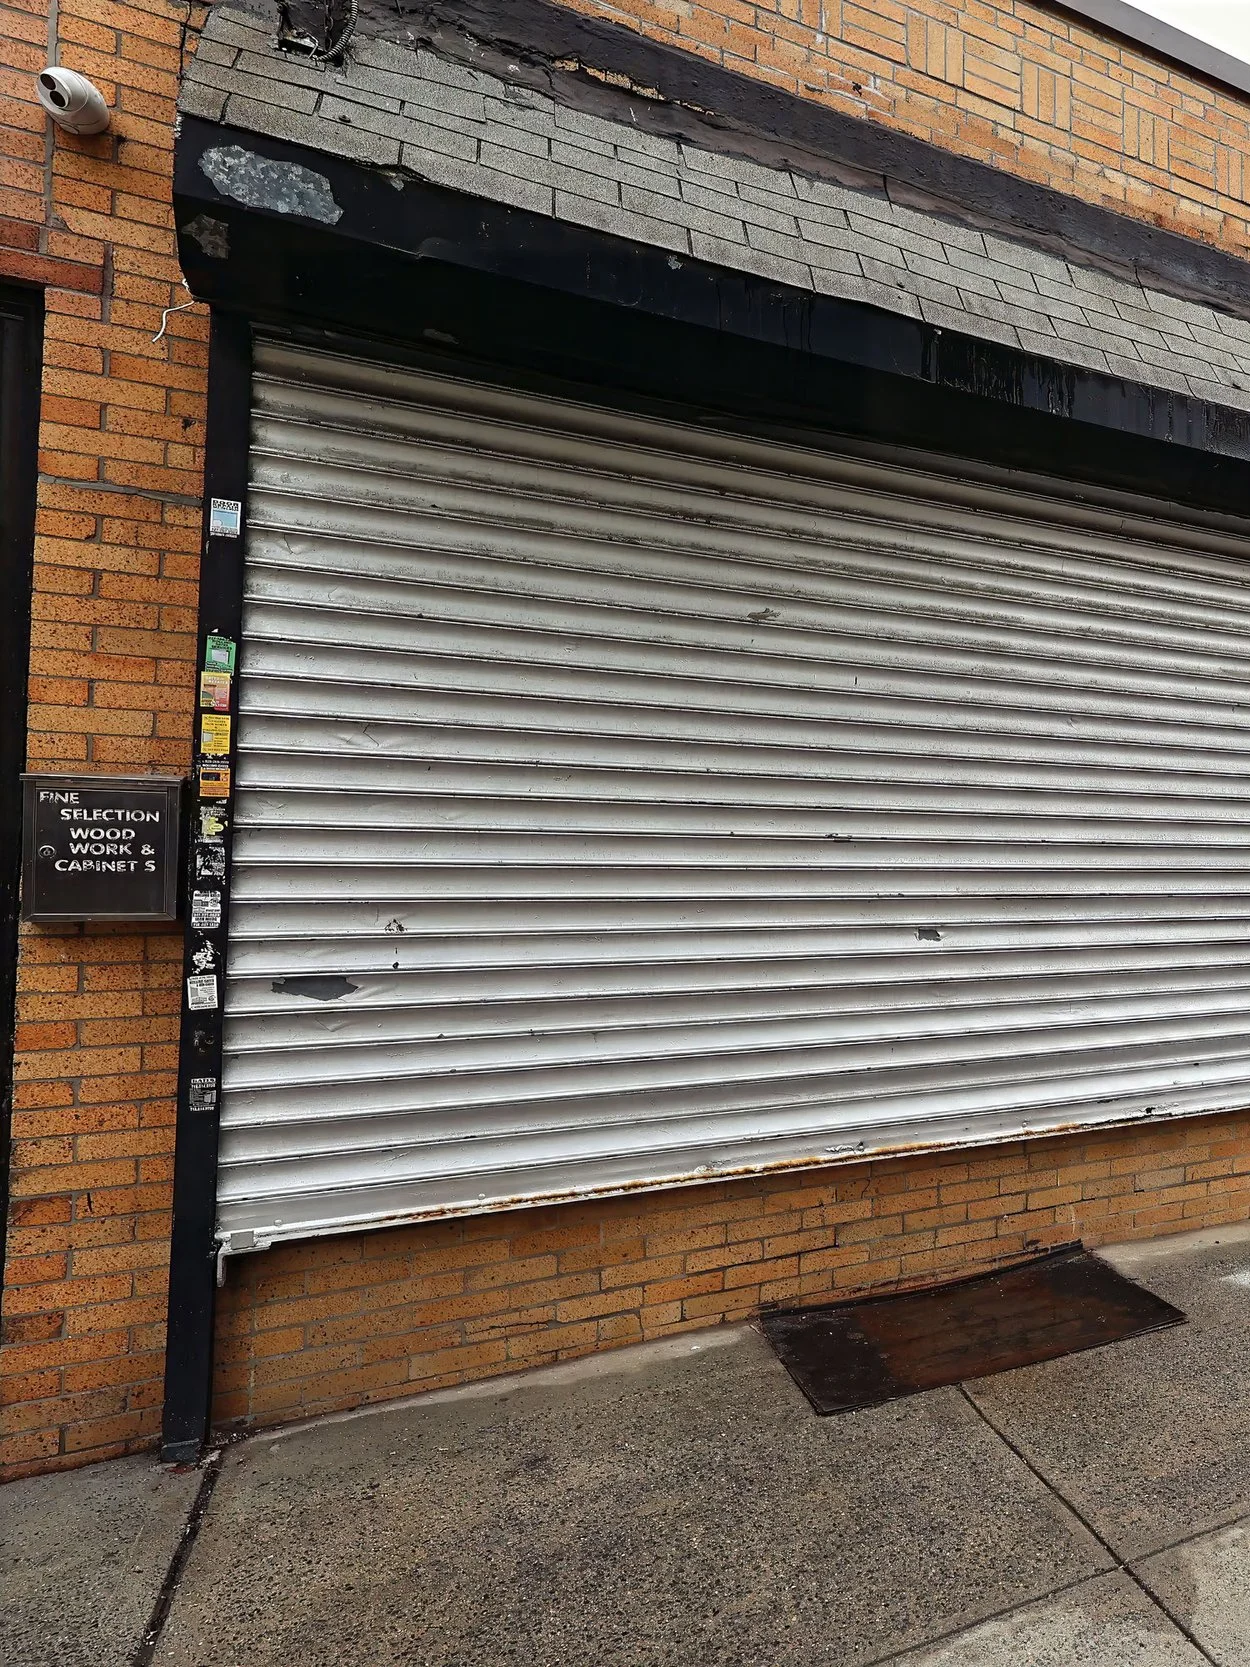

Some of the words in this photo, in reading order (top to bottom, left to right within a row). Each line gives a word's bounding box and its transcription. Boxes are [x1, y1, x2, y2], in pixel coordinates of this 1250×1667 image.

[39, 791, 80, 804] FINE
[60, 808, 160, 823] SELECTION
[69, 827, 136, 841] WOOD
[69, 842, 132, 855] WORK
[140, 843, 155, 855] &
[54, 859, 138, 872] CABINET
[144, 860, 156, 872] S
